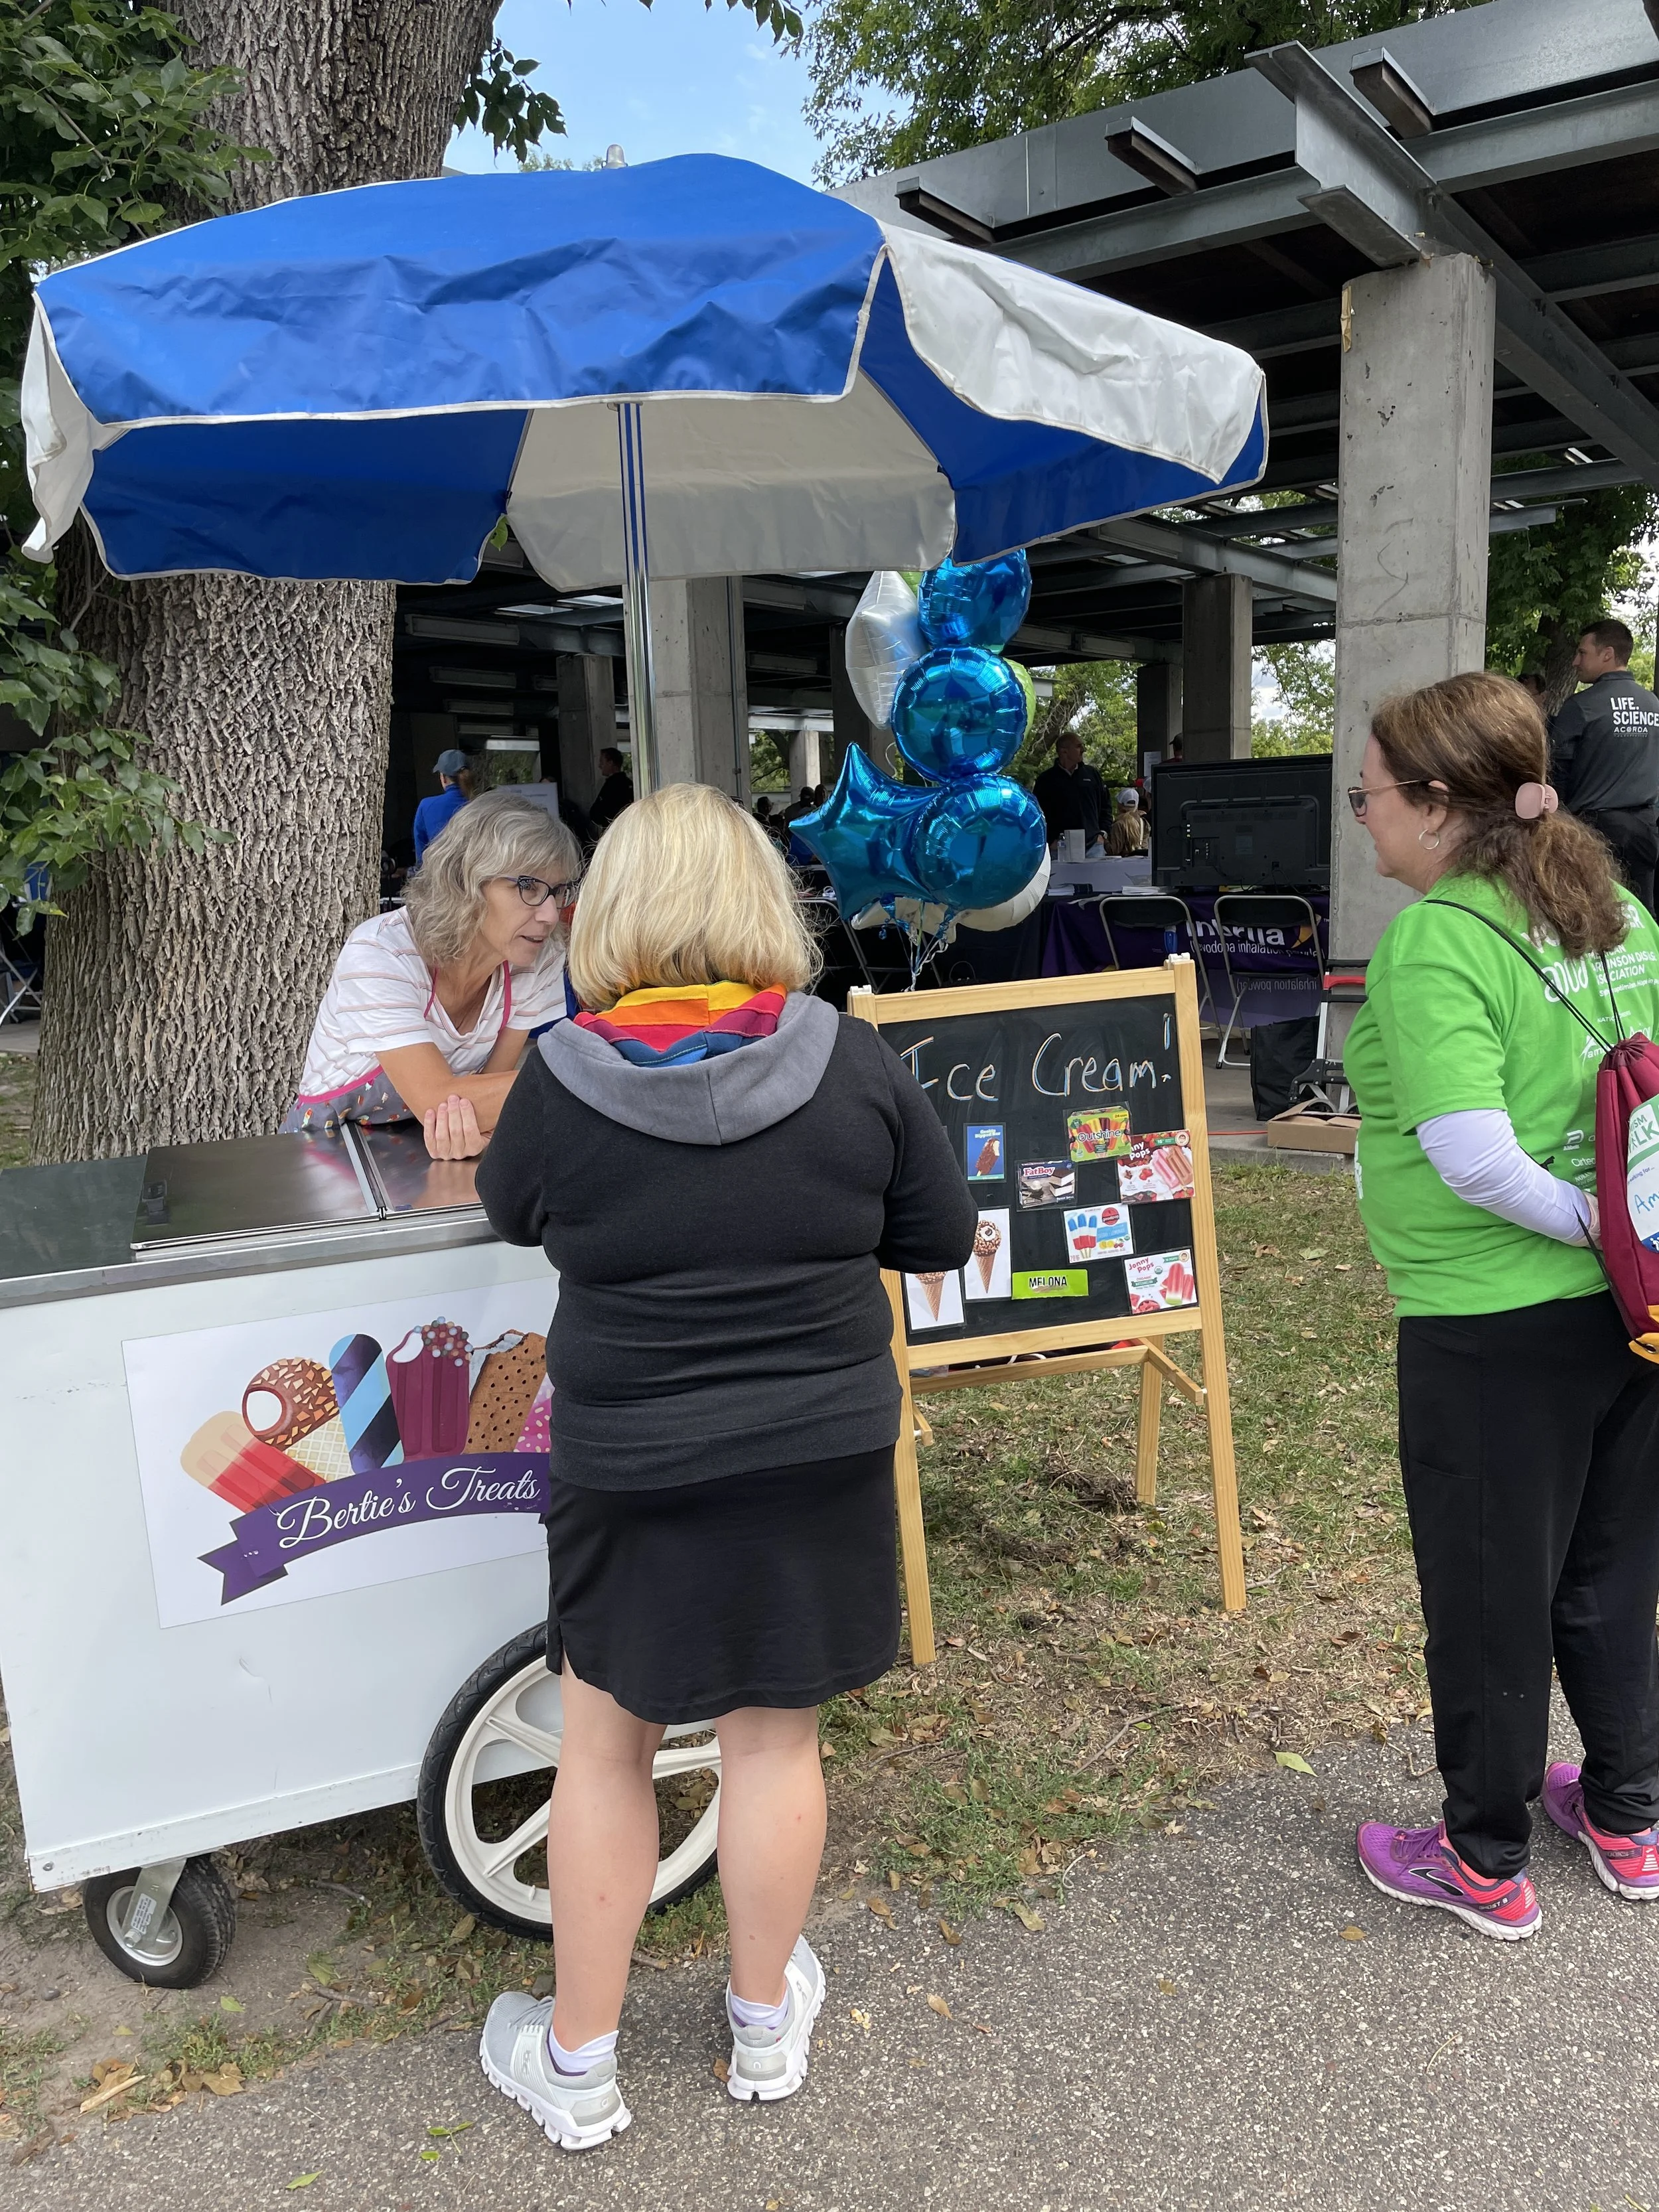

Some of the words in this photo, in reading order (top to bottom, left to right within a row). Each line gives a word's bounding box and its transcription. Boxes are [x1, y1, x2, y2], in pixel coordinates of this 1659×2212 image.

[1611, 697, 1639, 710] LIFE.
[1613, 711, 1659, 727] SCIENCE
[900, 1036, 998, 1102] Ice
[1078, 1129, 1121, 1143] Outshine
[1024, 1167, 1054, 1176] FatBoy
[1129, 1257, 1149, 1270] Jonny
[1029, 1276, 1067, 1288] MELONA
[275, 1478, 415, 1549] Bertie's
[425, 1467, 541, 1511] Treats
